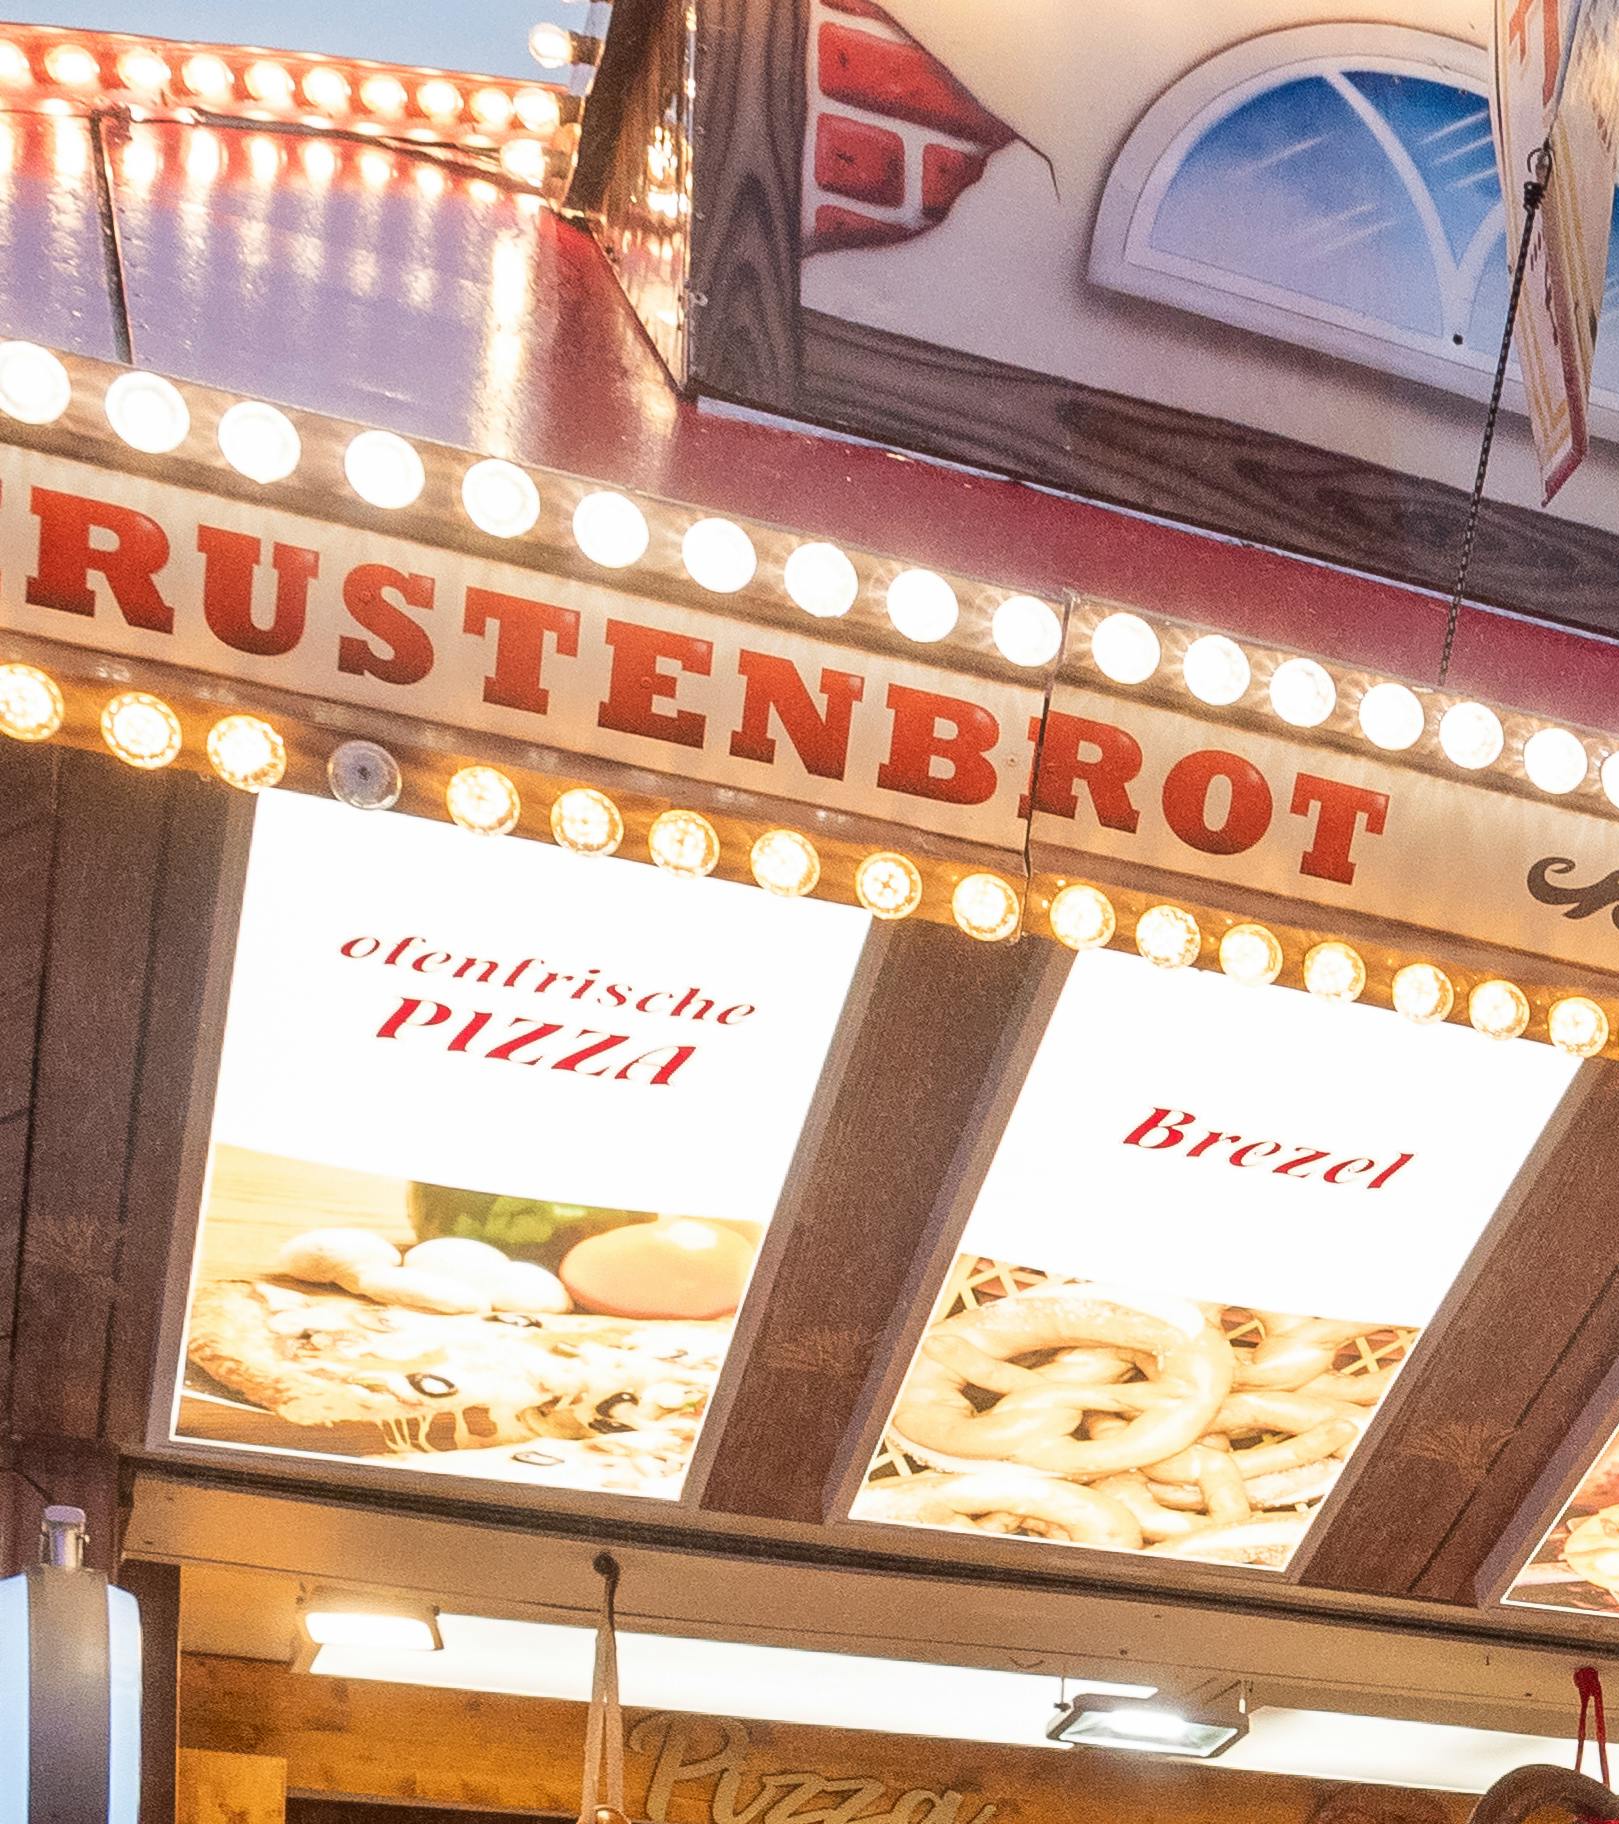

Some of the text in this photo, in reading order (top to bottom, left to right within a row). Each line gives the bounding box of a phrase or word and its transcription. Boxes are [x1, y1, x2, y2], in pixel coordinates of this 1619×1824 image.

[0, 484, 1390, 887] RUSTENBROT
[339, 930, 757, 1028] ofenfrische
[376, 995, 697, 1088] PIZZA
[1122, 1107, 1416, 1191] Brezel
